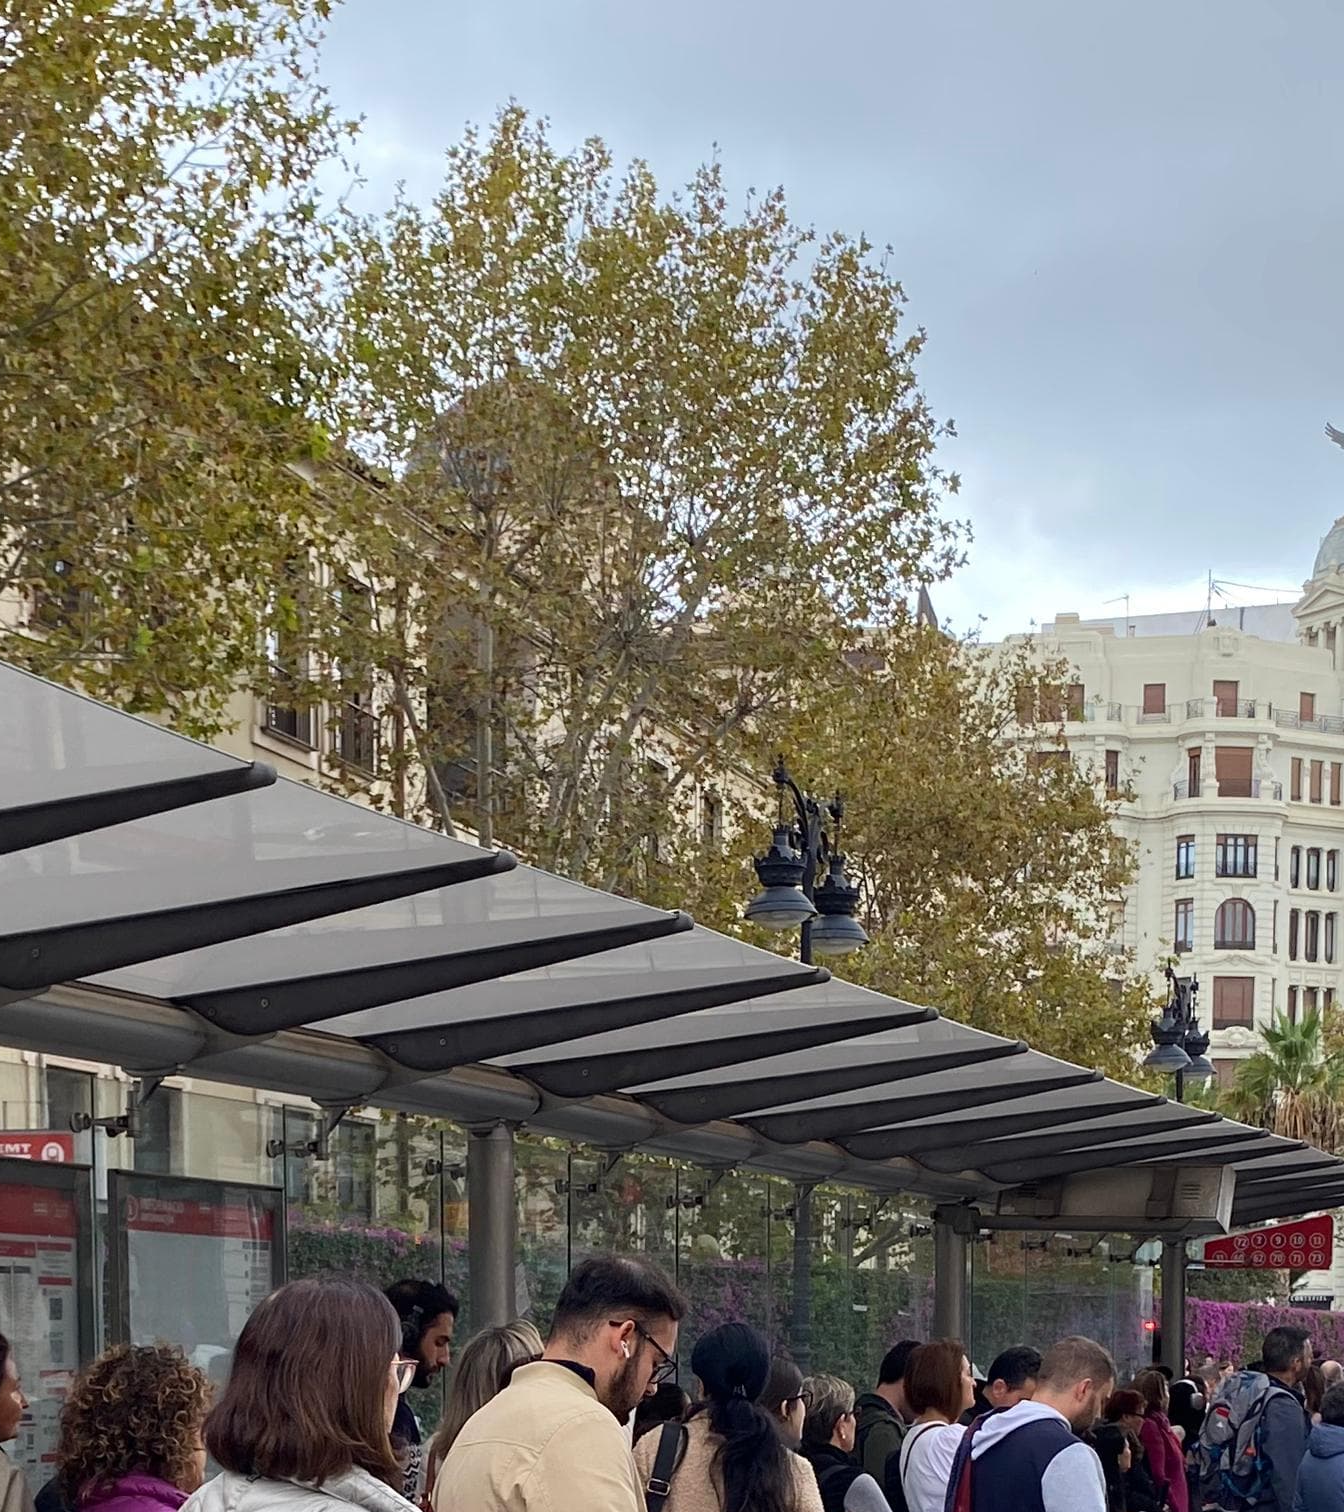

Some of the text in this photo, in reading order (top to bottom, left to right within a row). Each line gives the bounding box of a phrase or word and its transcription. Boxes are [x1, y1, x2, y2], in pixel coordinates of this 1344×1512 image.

[1291, 1235, 1304, 1246] 10
[1271, 1253, 1283, 1263] 70
[1310, 1253, 1322, 1264] 73
